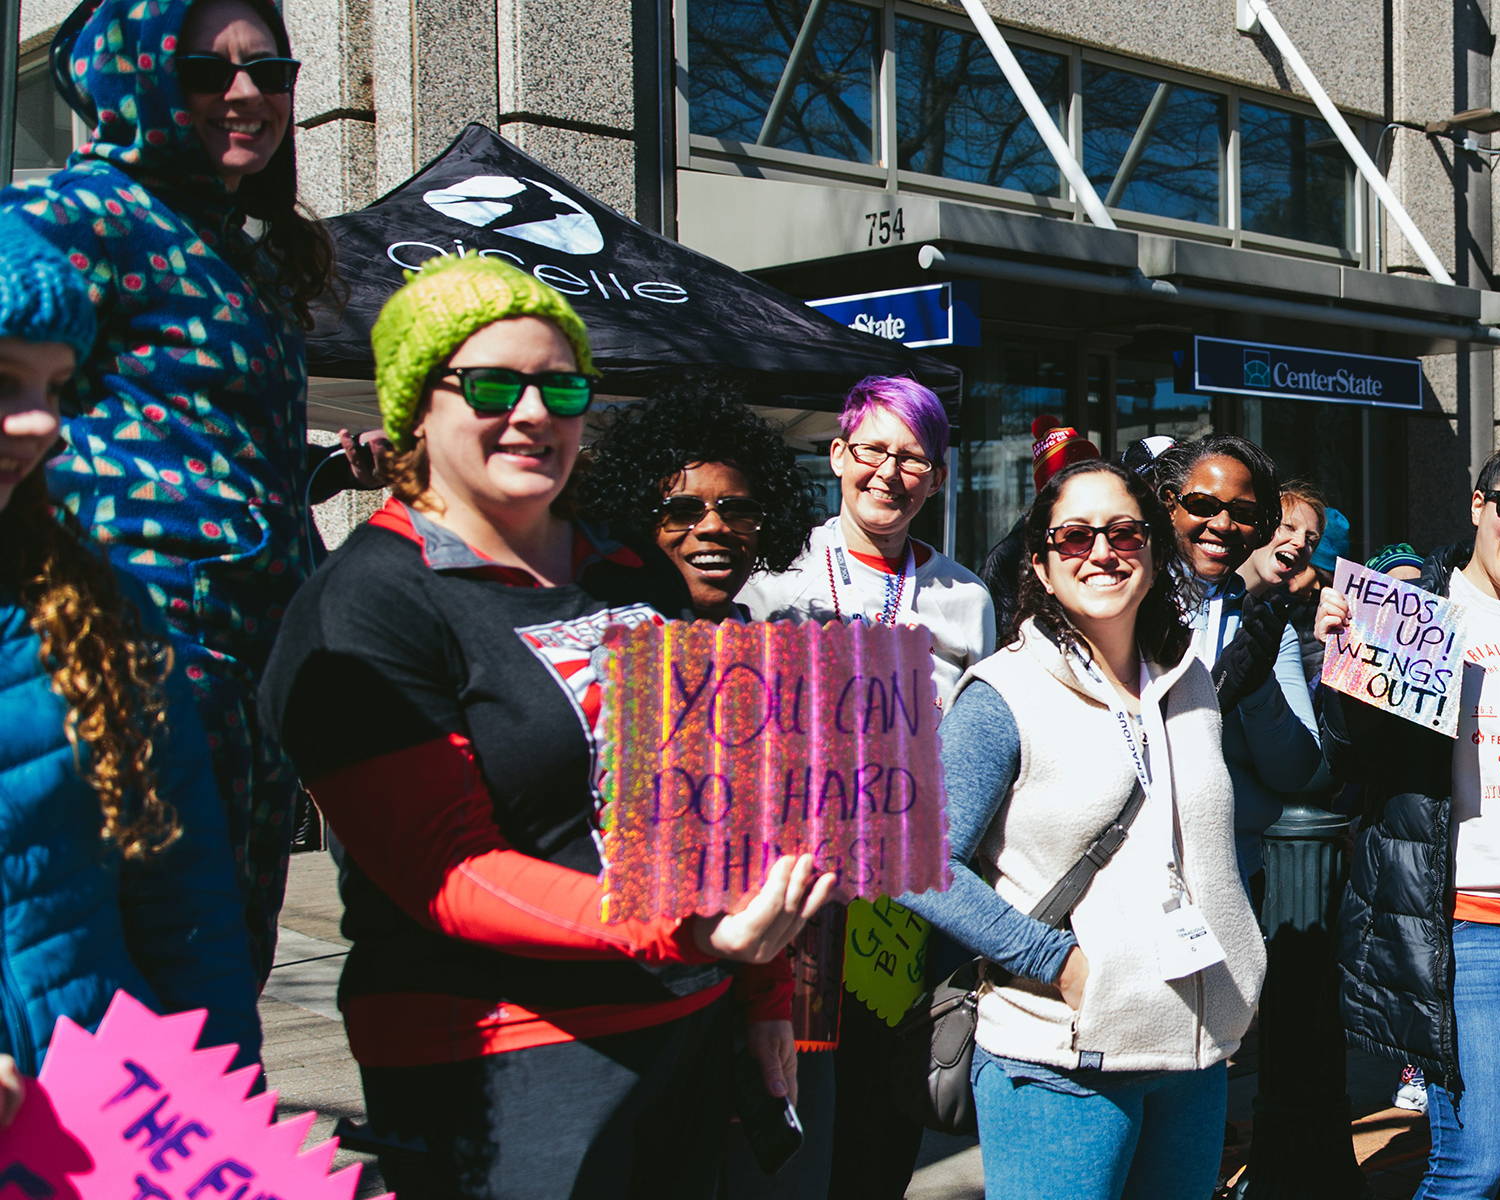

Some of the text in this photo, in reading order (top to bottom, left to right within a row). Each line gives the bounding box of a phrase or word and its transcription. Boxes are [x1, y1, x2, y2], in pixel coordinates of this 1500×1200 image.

[865, 208, 905, 246] 754
[1273, 362, 1383, 396] CenterState
[1345, 573, 1438, 624] HEADS
[1336, 633, 1453, 694] WINGS
[1396, 620, 1455, 661] UP!
[660, 660, 919, 752] YOU CAN
[1366, 673, 1448, 727] OUT!
[650, 762, 917, 827] DO HARD
[101, 1060, 213, 1172] THE
